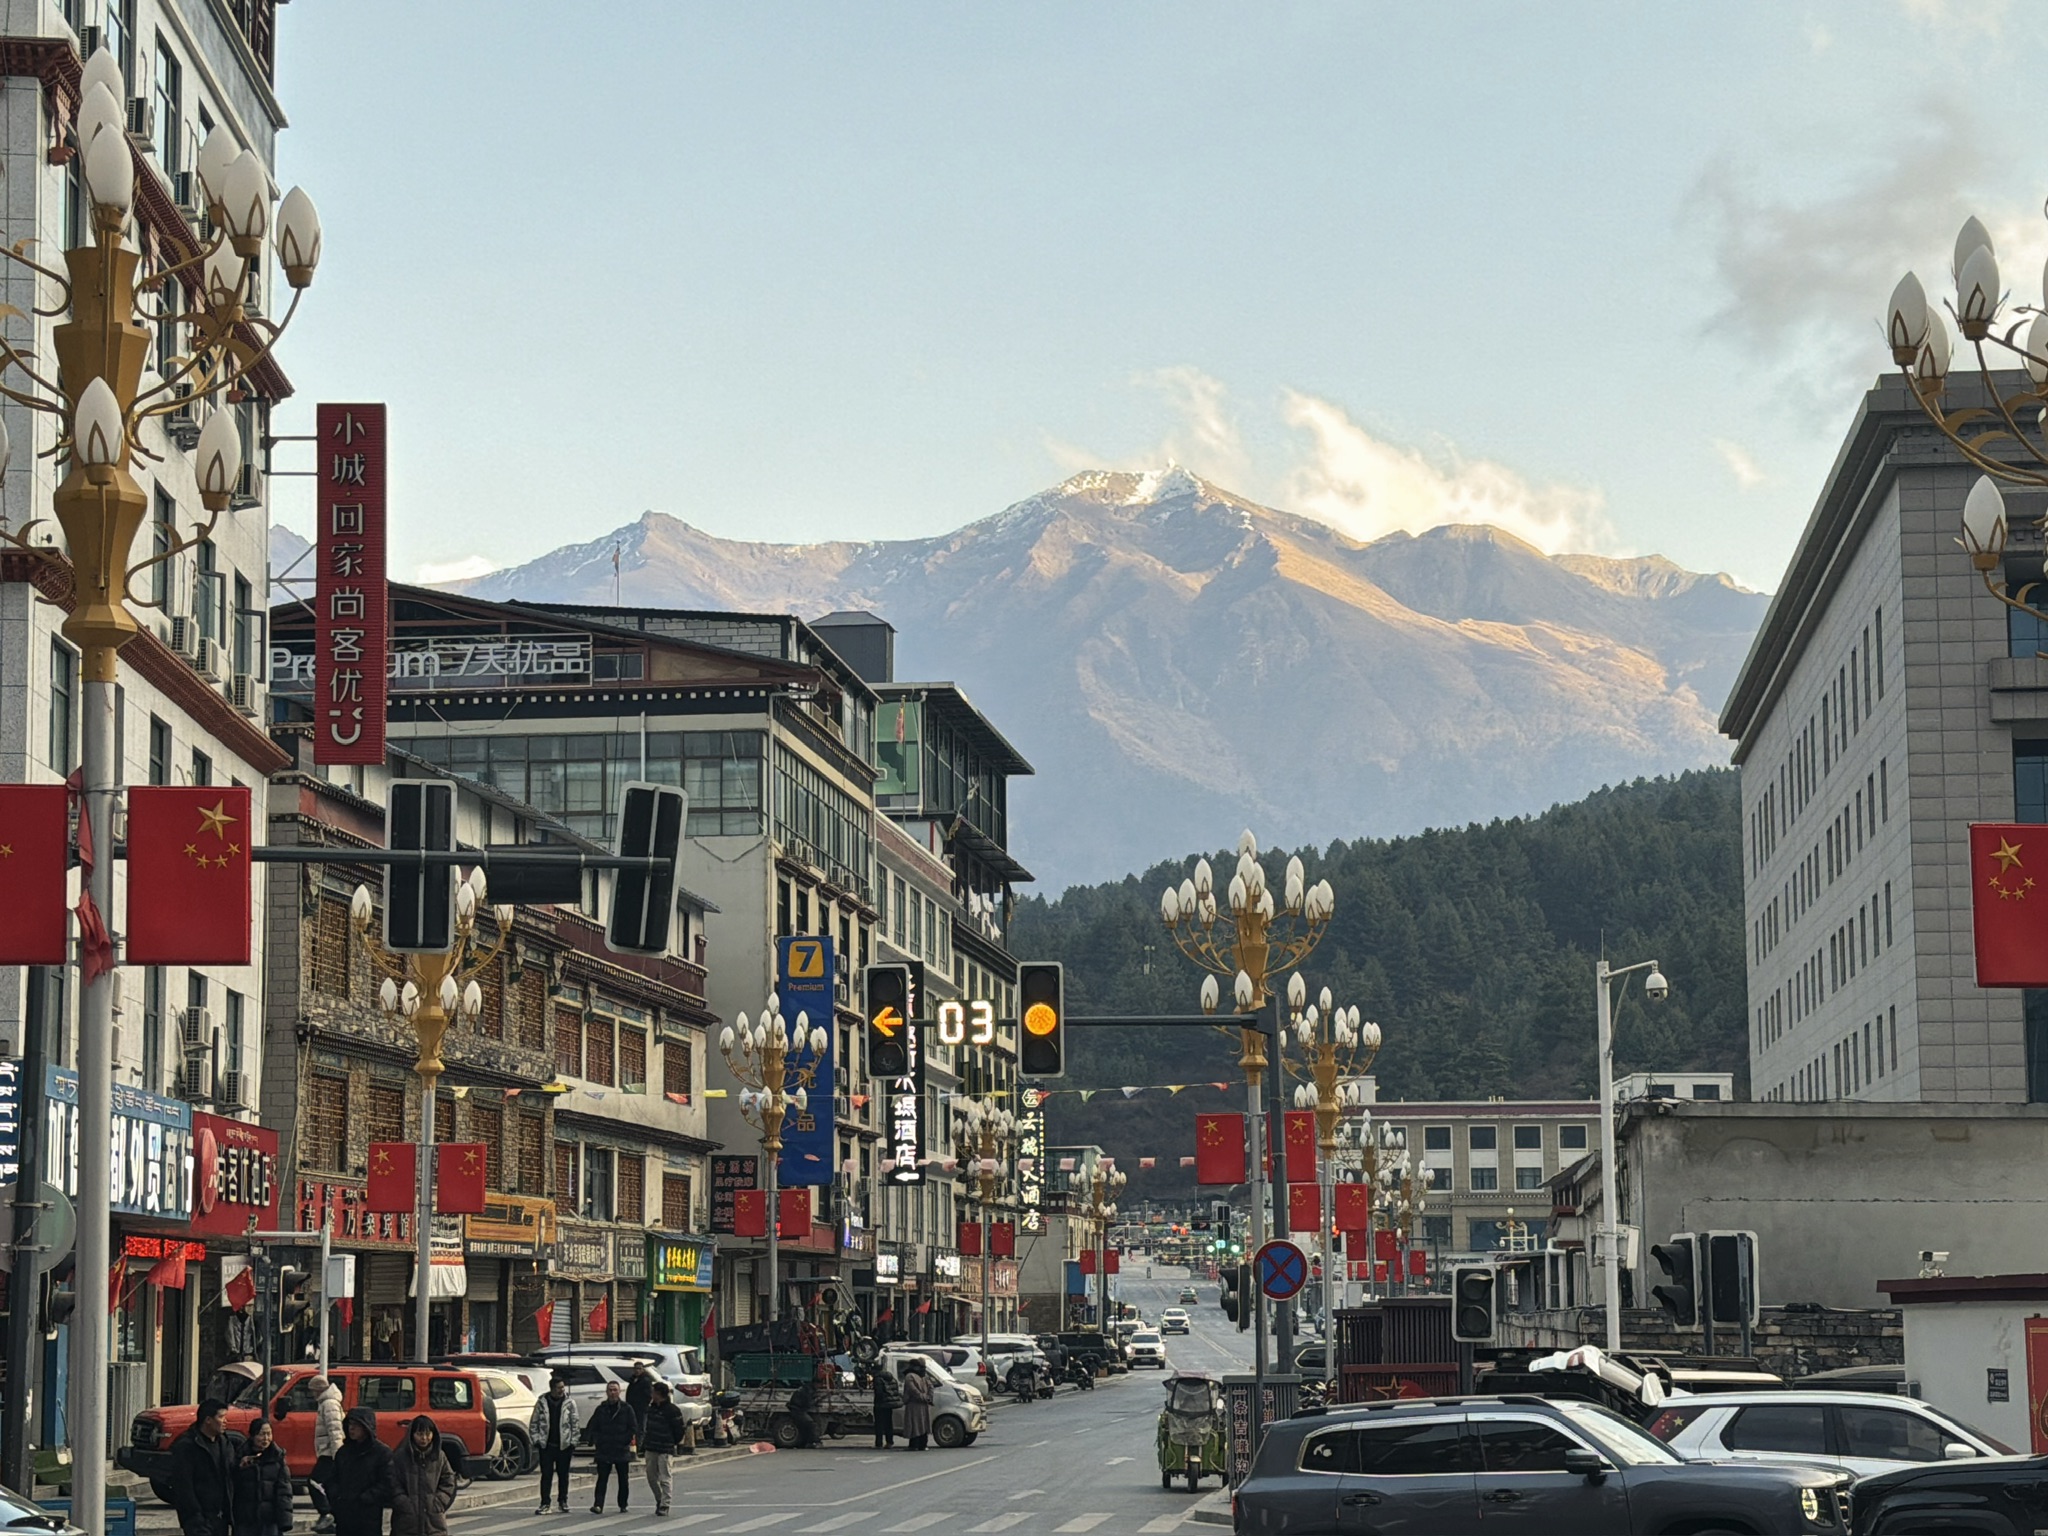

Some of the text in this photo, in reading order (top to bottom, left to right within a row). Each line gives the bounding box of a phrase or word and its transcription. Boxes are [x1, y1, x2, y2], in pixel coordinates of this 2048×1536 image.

[795, 945, 816, 973] 7
[788, 982, 825, 992] Premium
[938, 1001, 994, 1045] 03
[47, 1098, 195, 1214] 加都外贸商行
[1232, 1389, 1250, 1473] 一条吉隆沟
